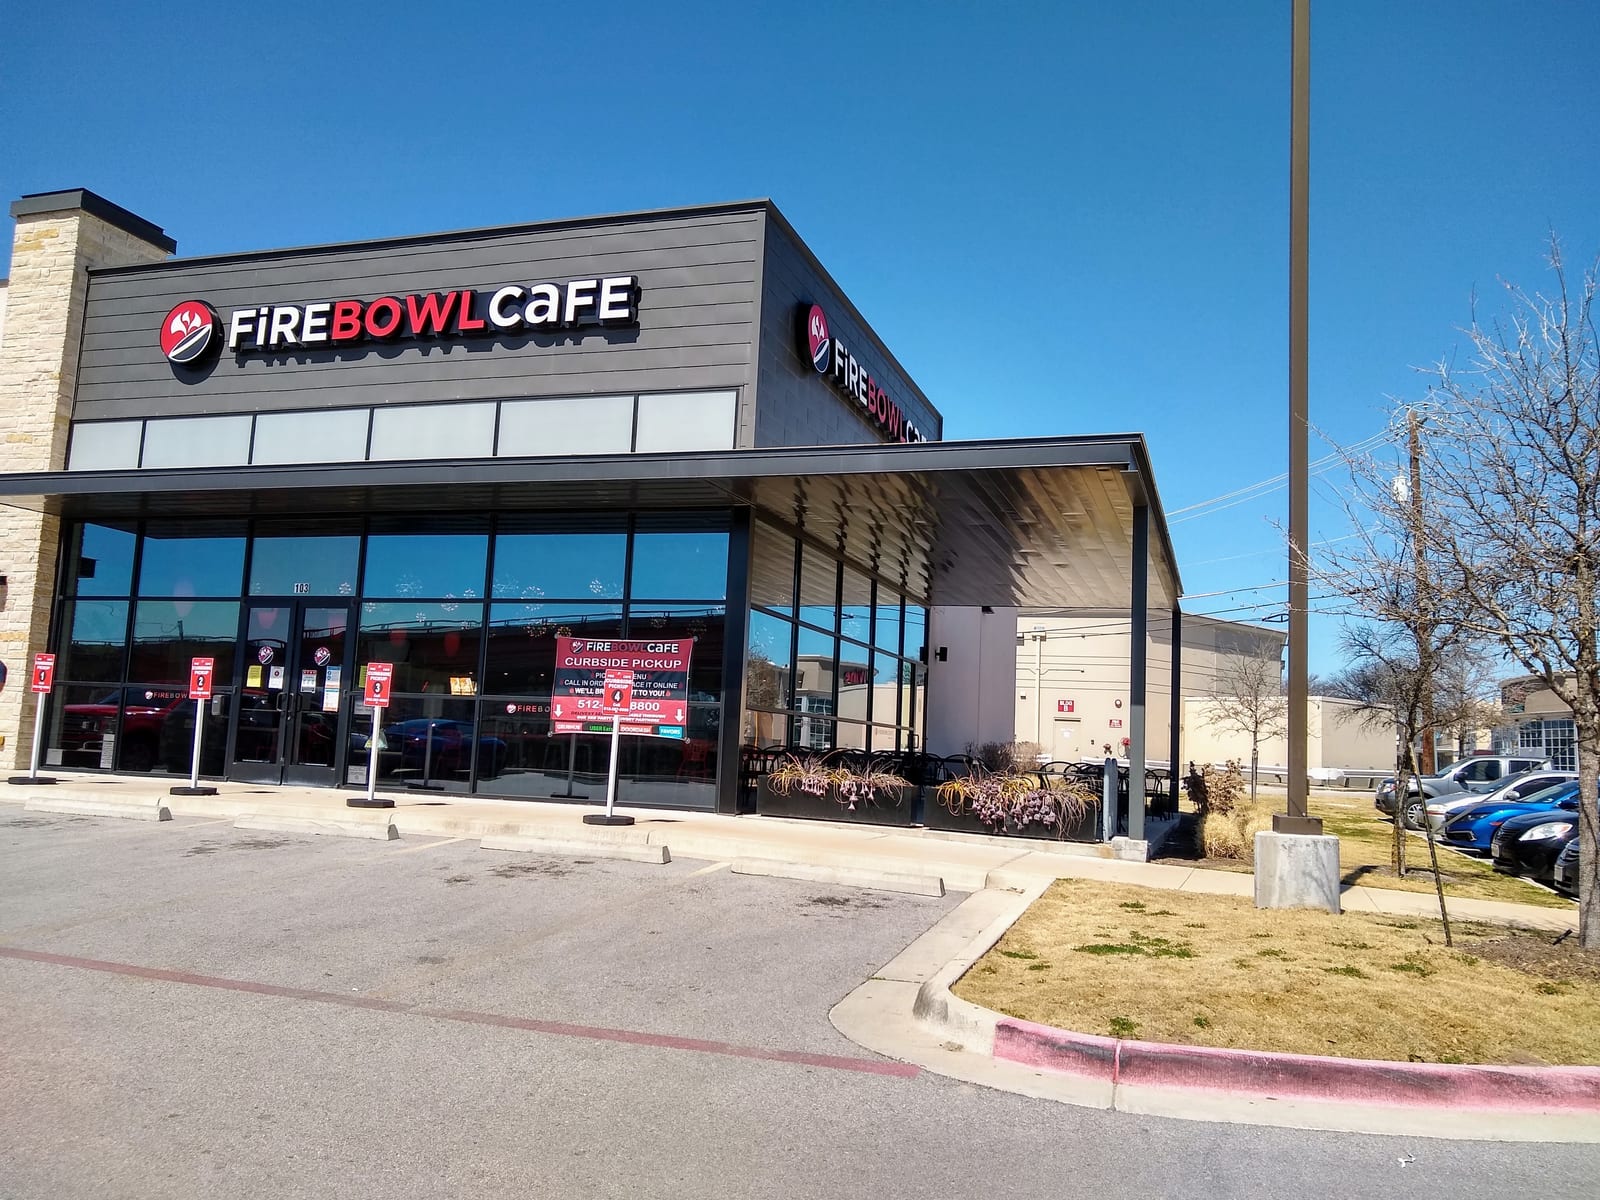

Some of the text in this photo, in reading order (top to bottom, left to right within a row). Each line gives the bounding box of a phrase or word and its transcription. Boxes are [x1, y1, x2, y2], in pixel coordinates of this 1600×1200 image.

[295, 583, 309, 593] 103
[564, 657, 682, 669] CURBSIDE PICKUP
[40, 671, 45, 681] 1
[198, 676, 204, 686] 2
[374, 682, 381, 693] 3
[153, 691, 188, 699] FIREBOW
[614, 690, 621, 702] 4
[517, 704, 551, 713] FIREBO
